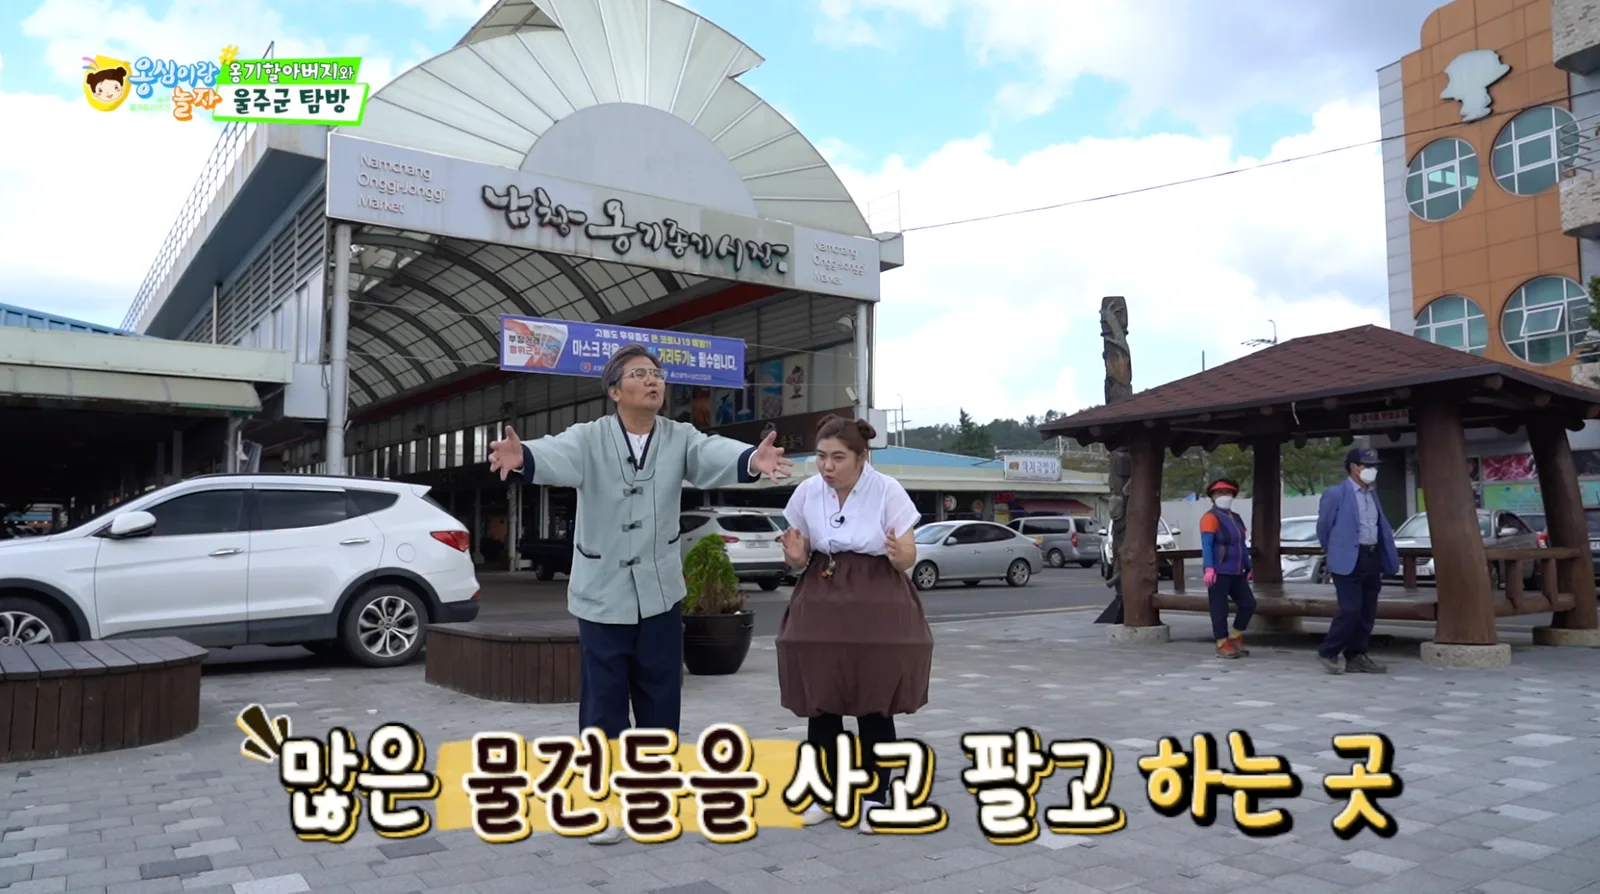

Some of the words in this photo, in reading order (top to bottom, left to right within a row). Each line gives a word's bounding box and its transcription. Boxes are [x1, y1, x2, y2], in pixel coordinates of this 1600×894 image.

[360, 153, 433, 182] Namchang
[359, 194, 405, 215] Market
[572, 339, 600, 358] 마스크
[659, 346, 697, 367] 거리두기는
